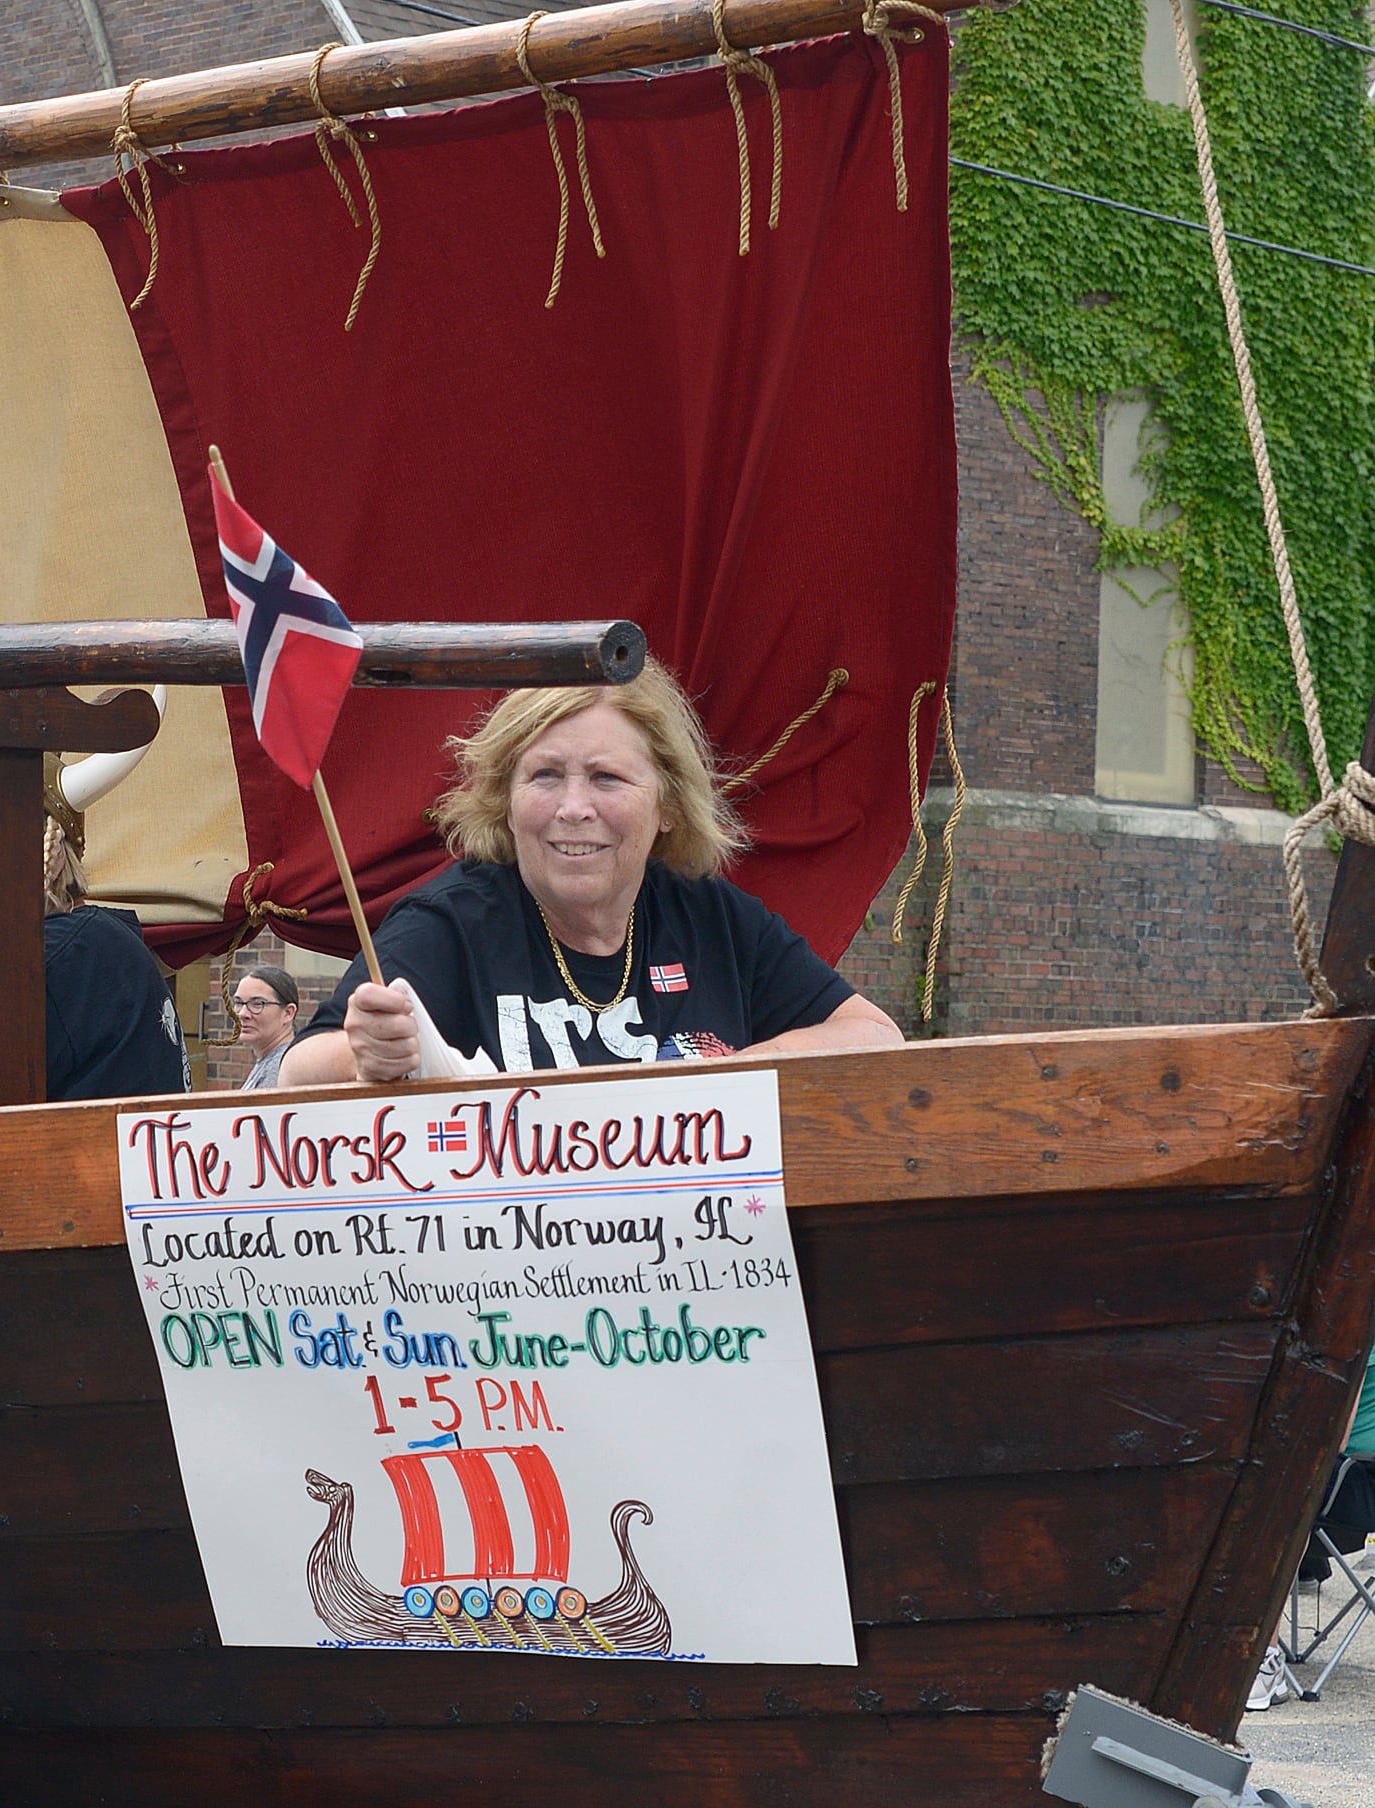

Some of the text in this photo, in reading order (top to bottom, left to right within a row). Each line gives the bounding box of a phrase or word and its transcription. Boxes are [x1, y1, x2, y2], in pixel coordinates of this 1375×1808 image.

[129, 1087, 752, 1199] The Norsk Museum
[142, 1215, 286, 1267] Located
[294, 1227, 342, 1257] on
[406, 1214, 446, 1252] 71
[463, 1215, 502, 1250] in
[230, 1265, 379, 1308] Permanent
[378, 1263, 524, 1316] Norwegian
[524, 1259, 651, 1299] Settlement
[657, 1267, 681, 1293] in
[160, 1308, 284, 1370] OPEN
[363, 1321, 380, 1358] &
[475, 1377, 564, 1432] P.M.
